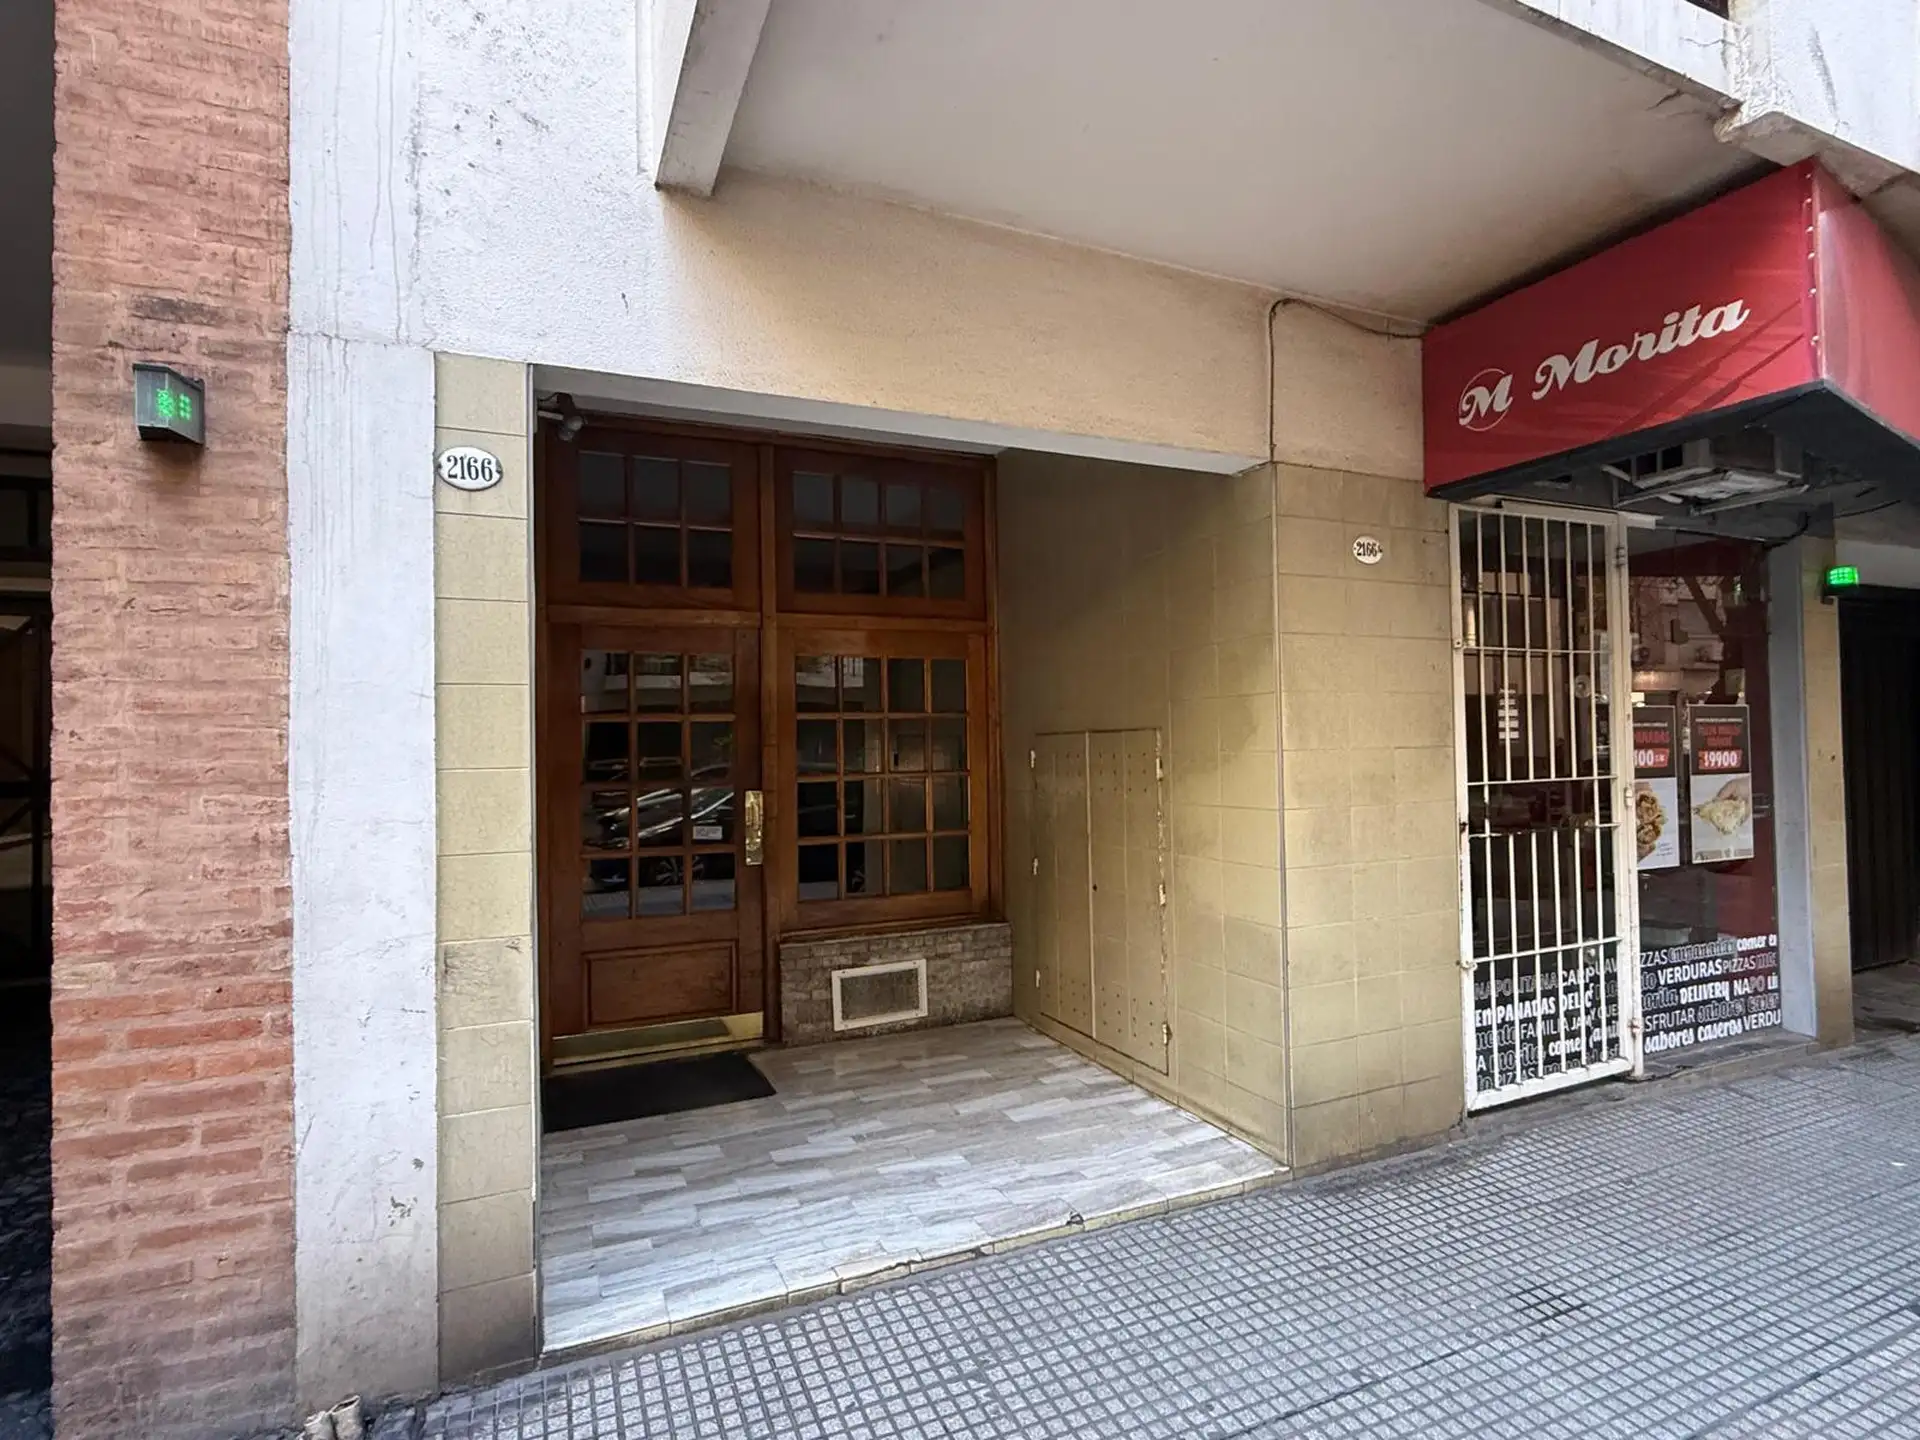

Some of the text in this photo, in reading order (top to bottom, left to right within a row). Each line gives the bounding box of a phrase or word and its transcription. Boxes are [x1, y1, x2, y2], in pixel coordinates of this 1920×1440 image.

[1459, 299, 1750, 415] M Morita
[446, 454, 494, 482] 2166
[1658, 960, 1722, 986] VERDURAS
[1723, 956, 1757, 973] PIZZAS
[1644, 1028, 1694, 1054] sabores
[1697, 1018, 1743, 1042] caseros
